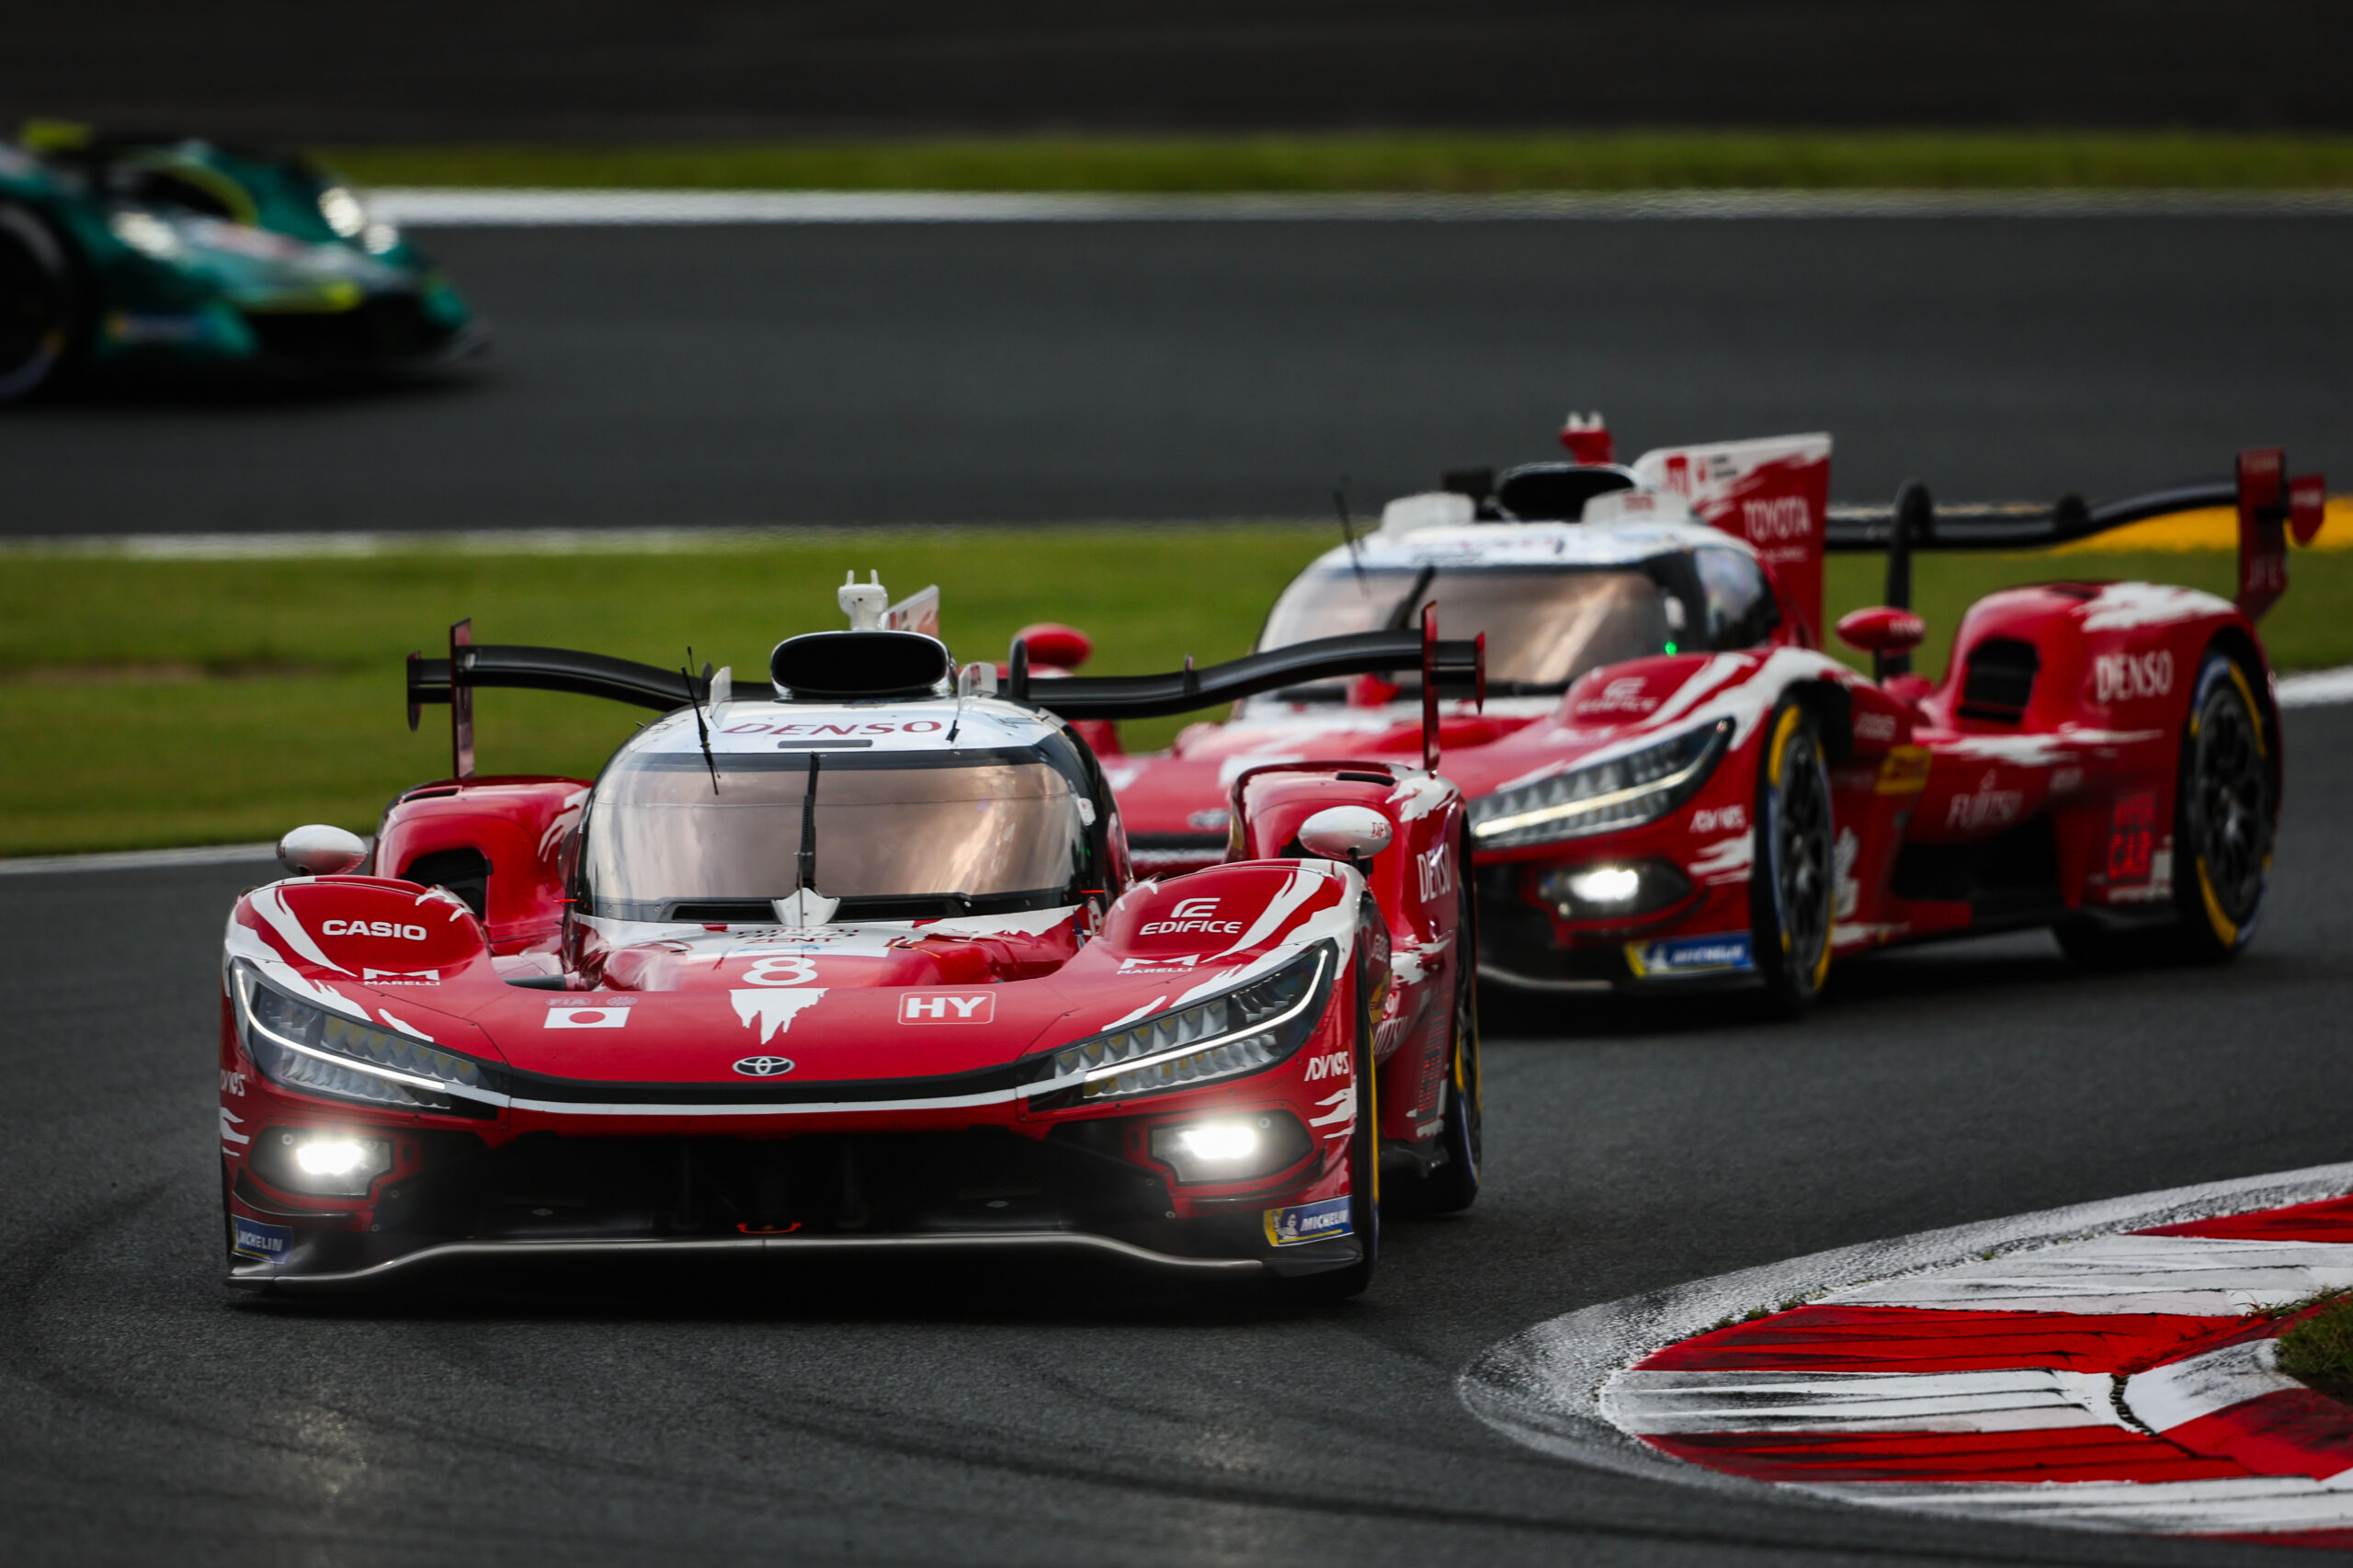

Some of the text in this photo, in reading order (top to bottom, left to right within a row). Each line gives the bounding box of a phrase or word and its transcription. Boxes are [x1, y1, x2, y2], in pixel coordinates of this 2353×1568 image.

[2095, 649, 2174, 702] DENSO
[721, 721, 942, 735] DENSO
[323, 920, 426, 941] CASIO
[1139, 920, 1244, 936] EDIFICE
[742, 956, 818, 986] 8
[905, 996, 988, 1018] HY
[1300, 1209, 1348, 1232] MICHELIN
